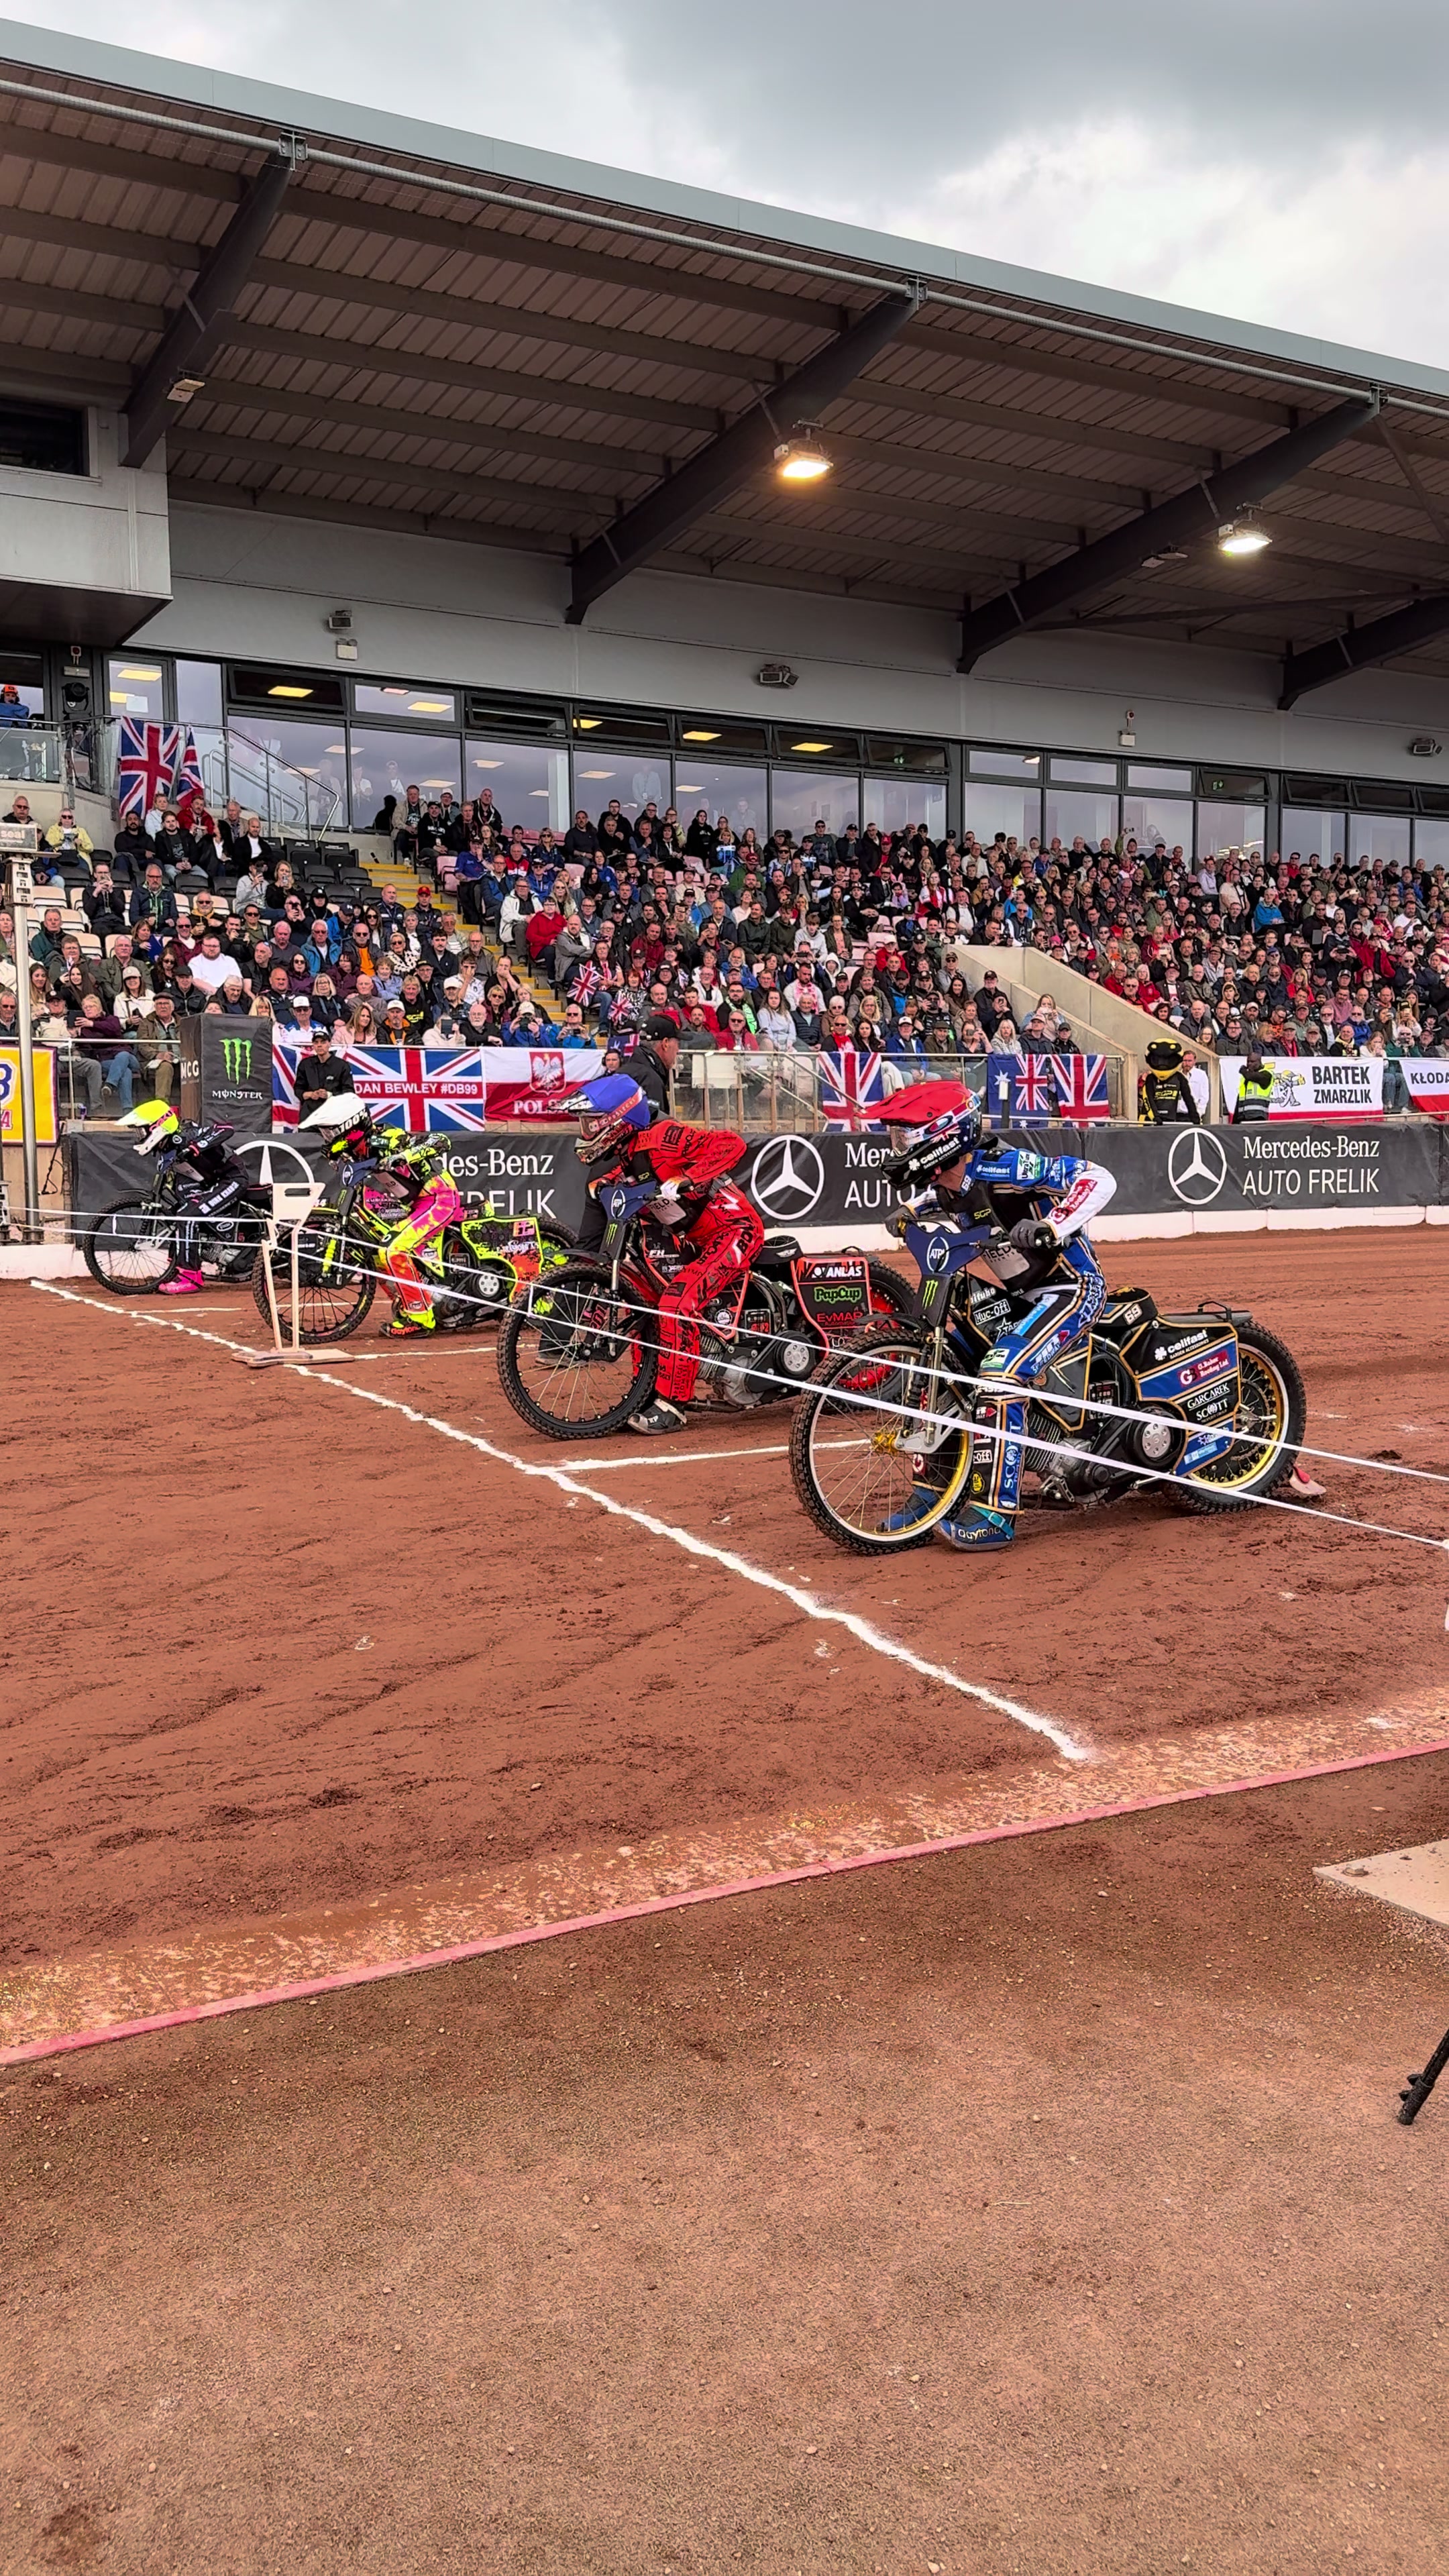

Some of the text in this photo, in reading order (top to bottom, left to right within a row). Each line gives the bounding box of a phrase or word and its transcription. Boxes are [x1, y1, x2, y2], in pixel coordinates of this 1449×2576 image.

[180, 1060, 199, 1079] MCG
[1312, 1066, 1370, 1085] BARTEK
[212, 1089, 263, 1099] MONSTER
[355, 1083, 477, 1095] DAN BEWLEY #DB99
[1313, 1089, 1373, 1104] ZMARZLIK
[337, 1109, 368, 1132] 100%
[920, 1137, 960, 1164] cellfast
[1243, 1135, 1380, 1159] Mercedes-Benz
[1242, 1169, 1379, 1195] AUTO FRELIK
[974, 1208, 991, 1220] SGP
[814, 1286, 861, 1303] PapCup
[975, 1301, 1008, 1322] Muc-Off
[1124, 1305, 1142, 1324] 69
[1167, 1330, 1208, 1353] cellfast
[973, 1452, 991, 1462] -Off
